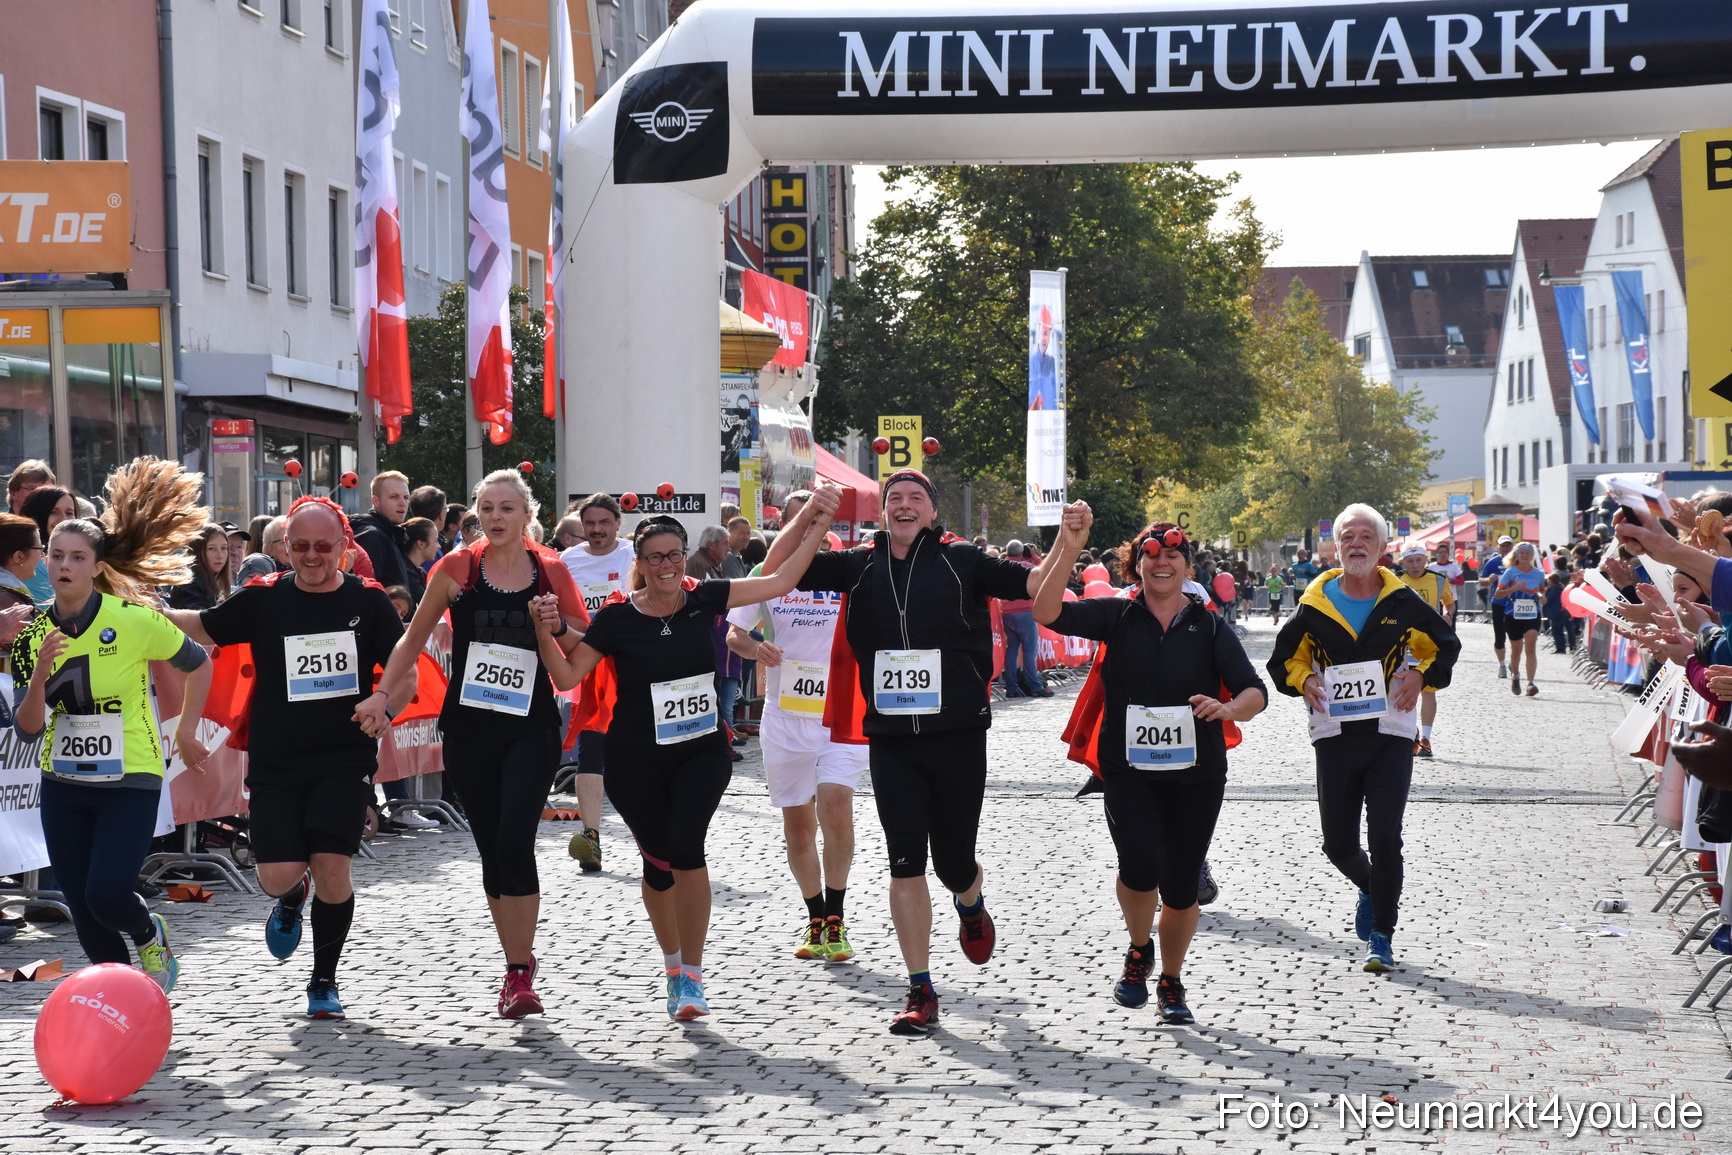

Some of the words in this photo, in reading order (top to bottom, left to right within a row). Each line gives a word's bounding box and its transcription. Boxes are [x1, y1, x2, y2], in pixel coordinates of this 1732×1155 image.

[838, 29, 1054, 97] MINI
[1081, 3, 1647, 95] NEUMARKT.
[656, 116, 684, 128] MINI
[883, 419, 917, 431] Block
[890, 436, 911, 467] B
[1174, 502, 1194, 510] Block
[1177, 512, 1190, 529] C
[1237, 531, 1247, 544] D
[1509, 526, 1519, 539] D
[584, 595, 611, 611] 207
[779, 595, 810, 605] TEAM
[791, 619, 828, 627] FEUCHT
[297, 652, 348, 675] 2518
[474, 662, 525, 689] 2565
[883, 669, 930, 689] 2139
[313, 680, 334, 688] Ralph
[793, 678, 825, 697] 404
[1333, 679, 1376, 700] 2212
[483, 690, 509, 701] Claudia
[664, 693, 710, 719] 2155
[1343, 703, 1370, 711] Raimund
[677, 721, 700, 731] Brigitte
[1136, 725, 1182, 746] 2041
[61, 735, 112, 757] 2660
[1150, 752, 1172, 760] Gisela
